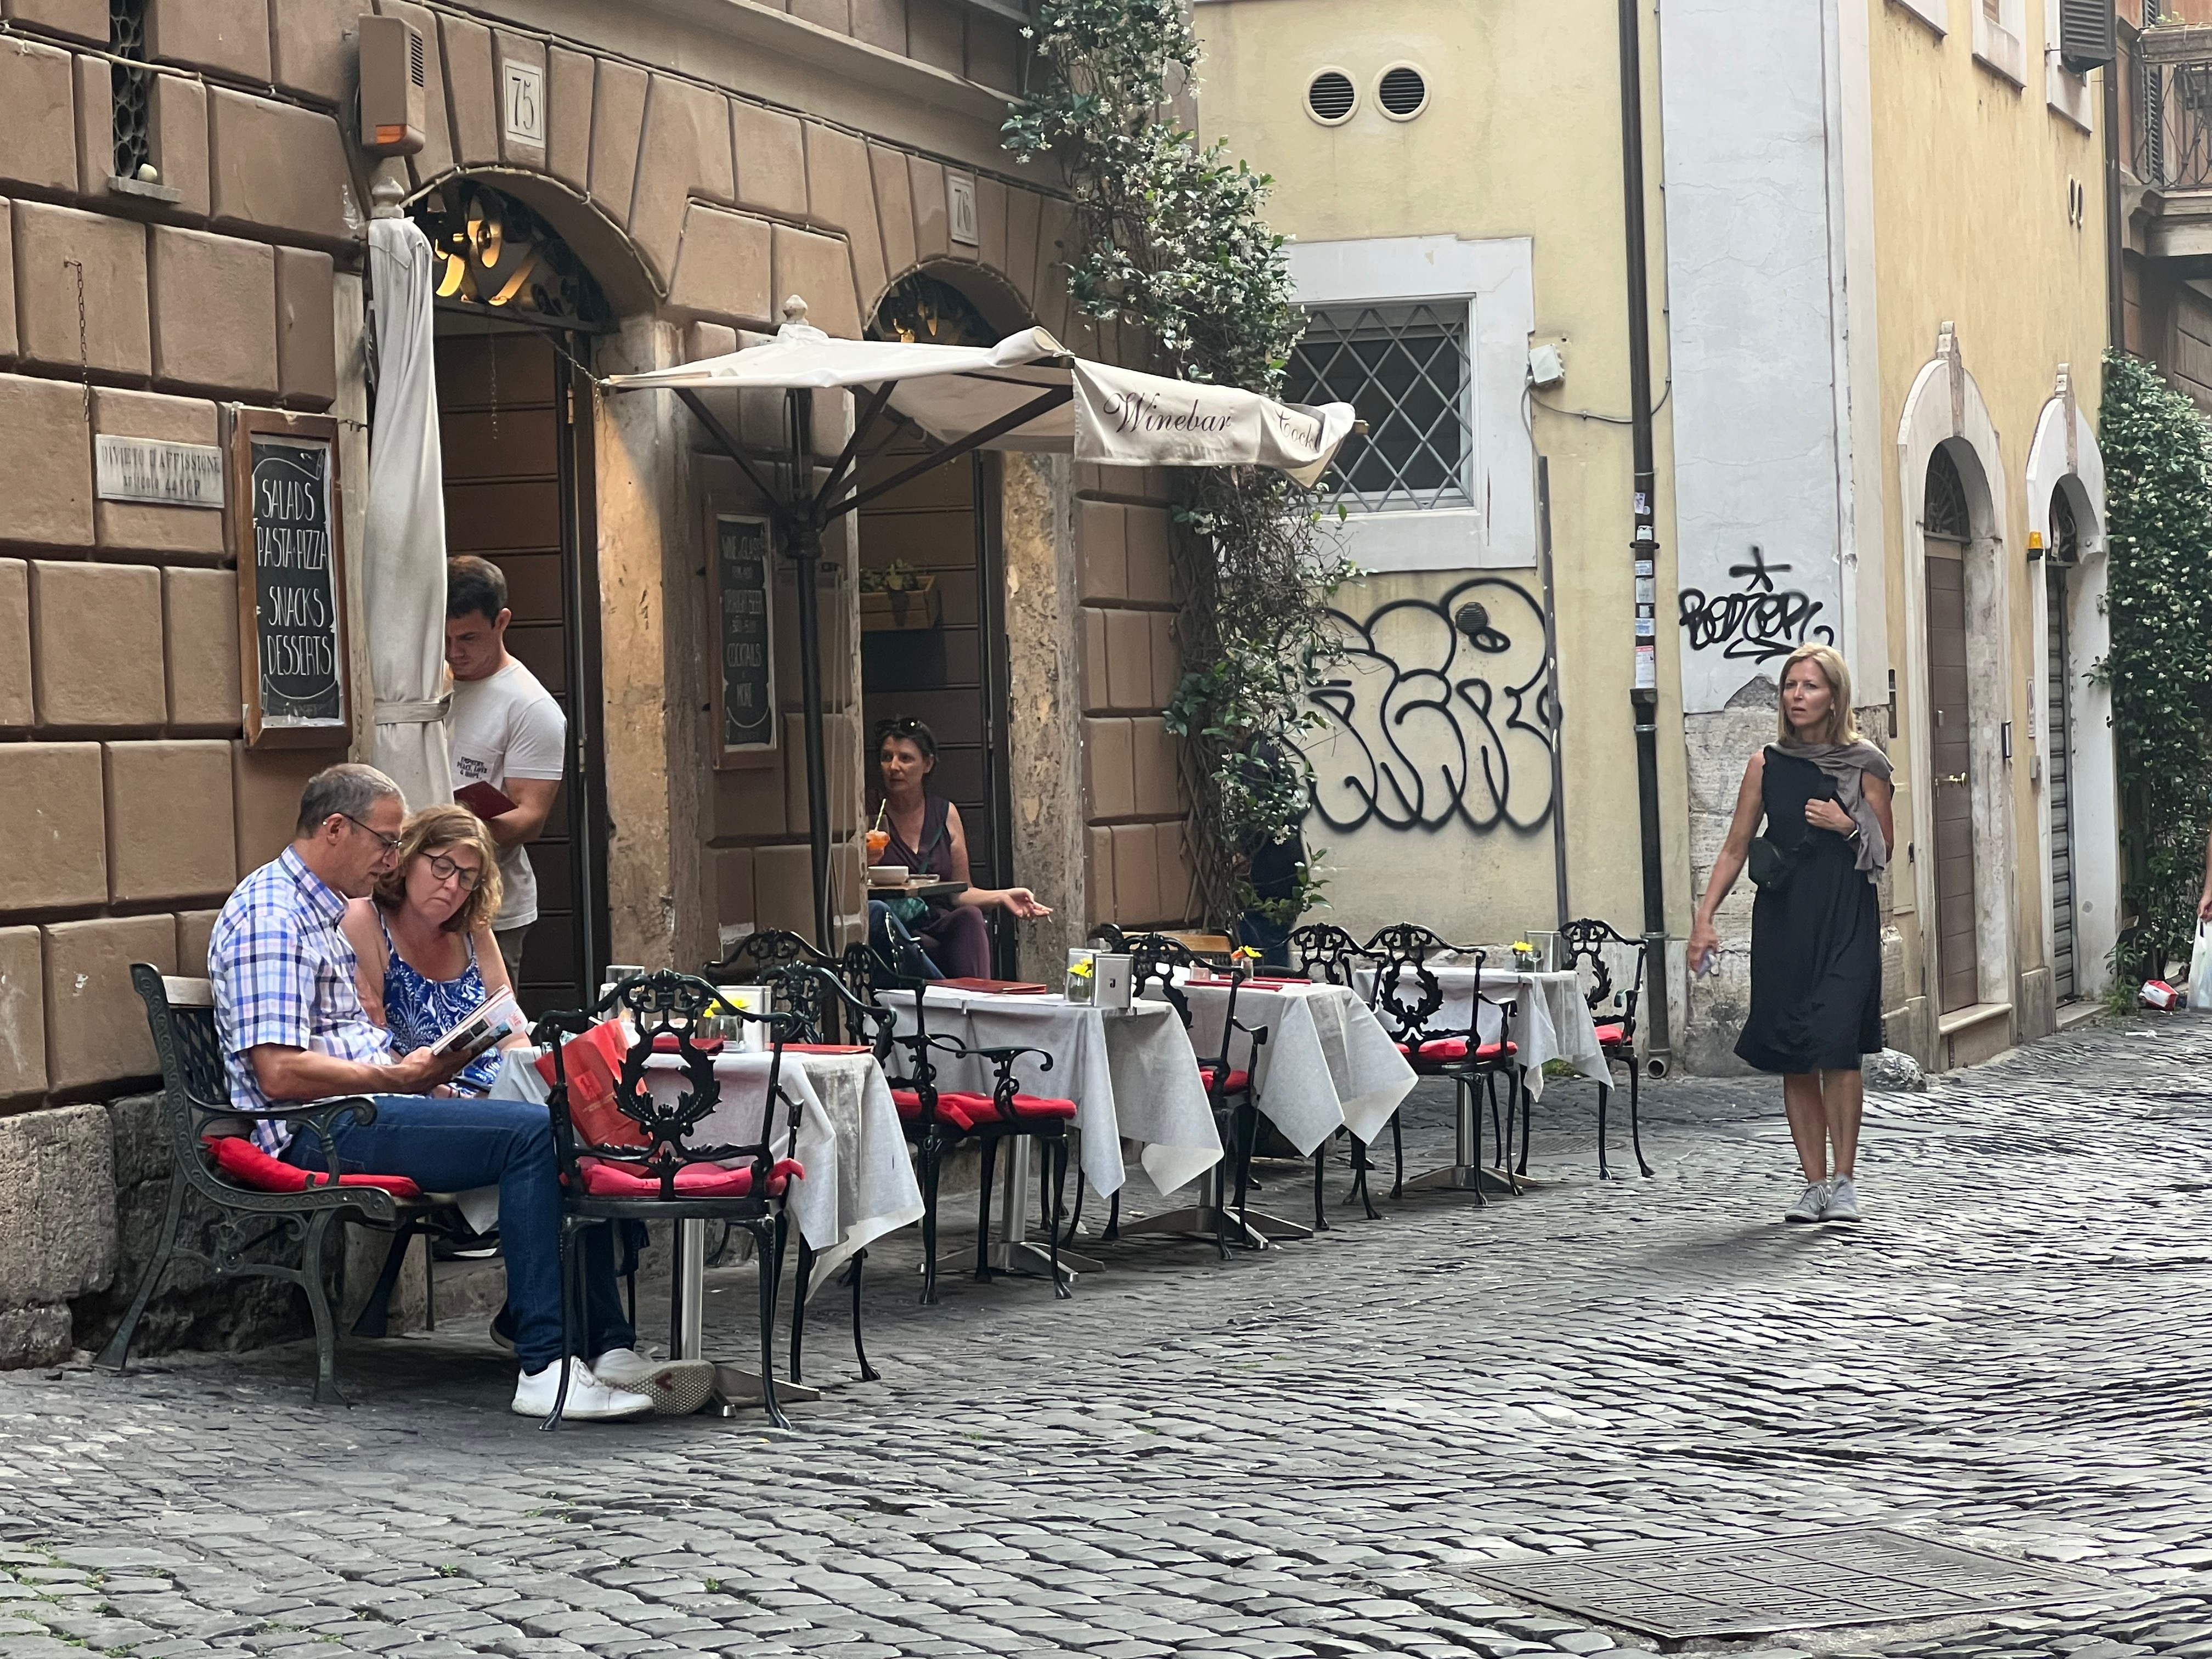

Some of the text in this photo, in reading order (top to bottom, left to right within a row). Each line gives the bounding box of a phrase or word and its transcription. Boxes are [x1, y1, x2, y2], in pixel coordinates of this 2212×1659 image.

[511, 76, 534, 130] 75
[954, 188, 972, 232] 76
[1103, 392, 1232, 434] Winebar
[101, 445, 144, 466] DIVIETO
[261, 478, 315, 521] SALADS
[268, 585, 325, 628] SNACKS
[267, 634, 332, 676] DESSERTS
[727, 642, 761, 667] COCKTAILS
